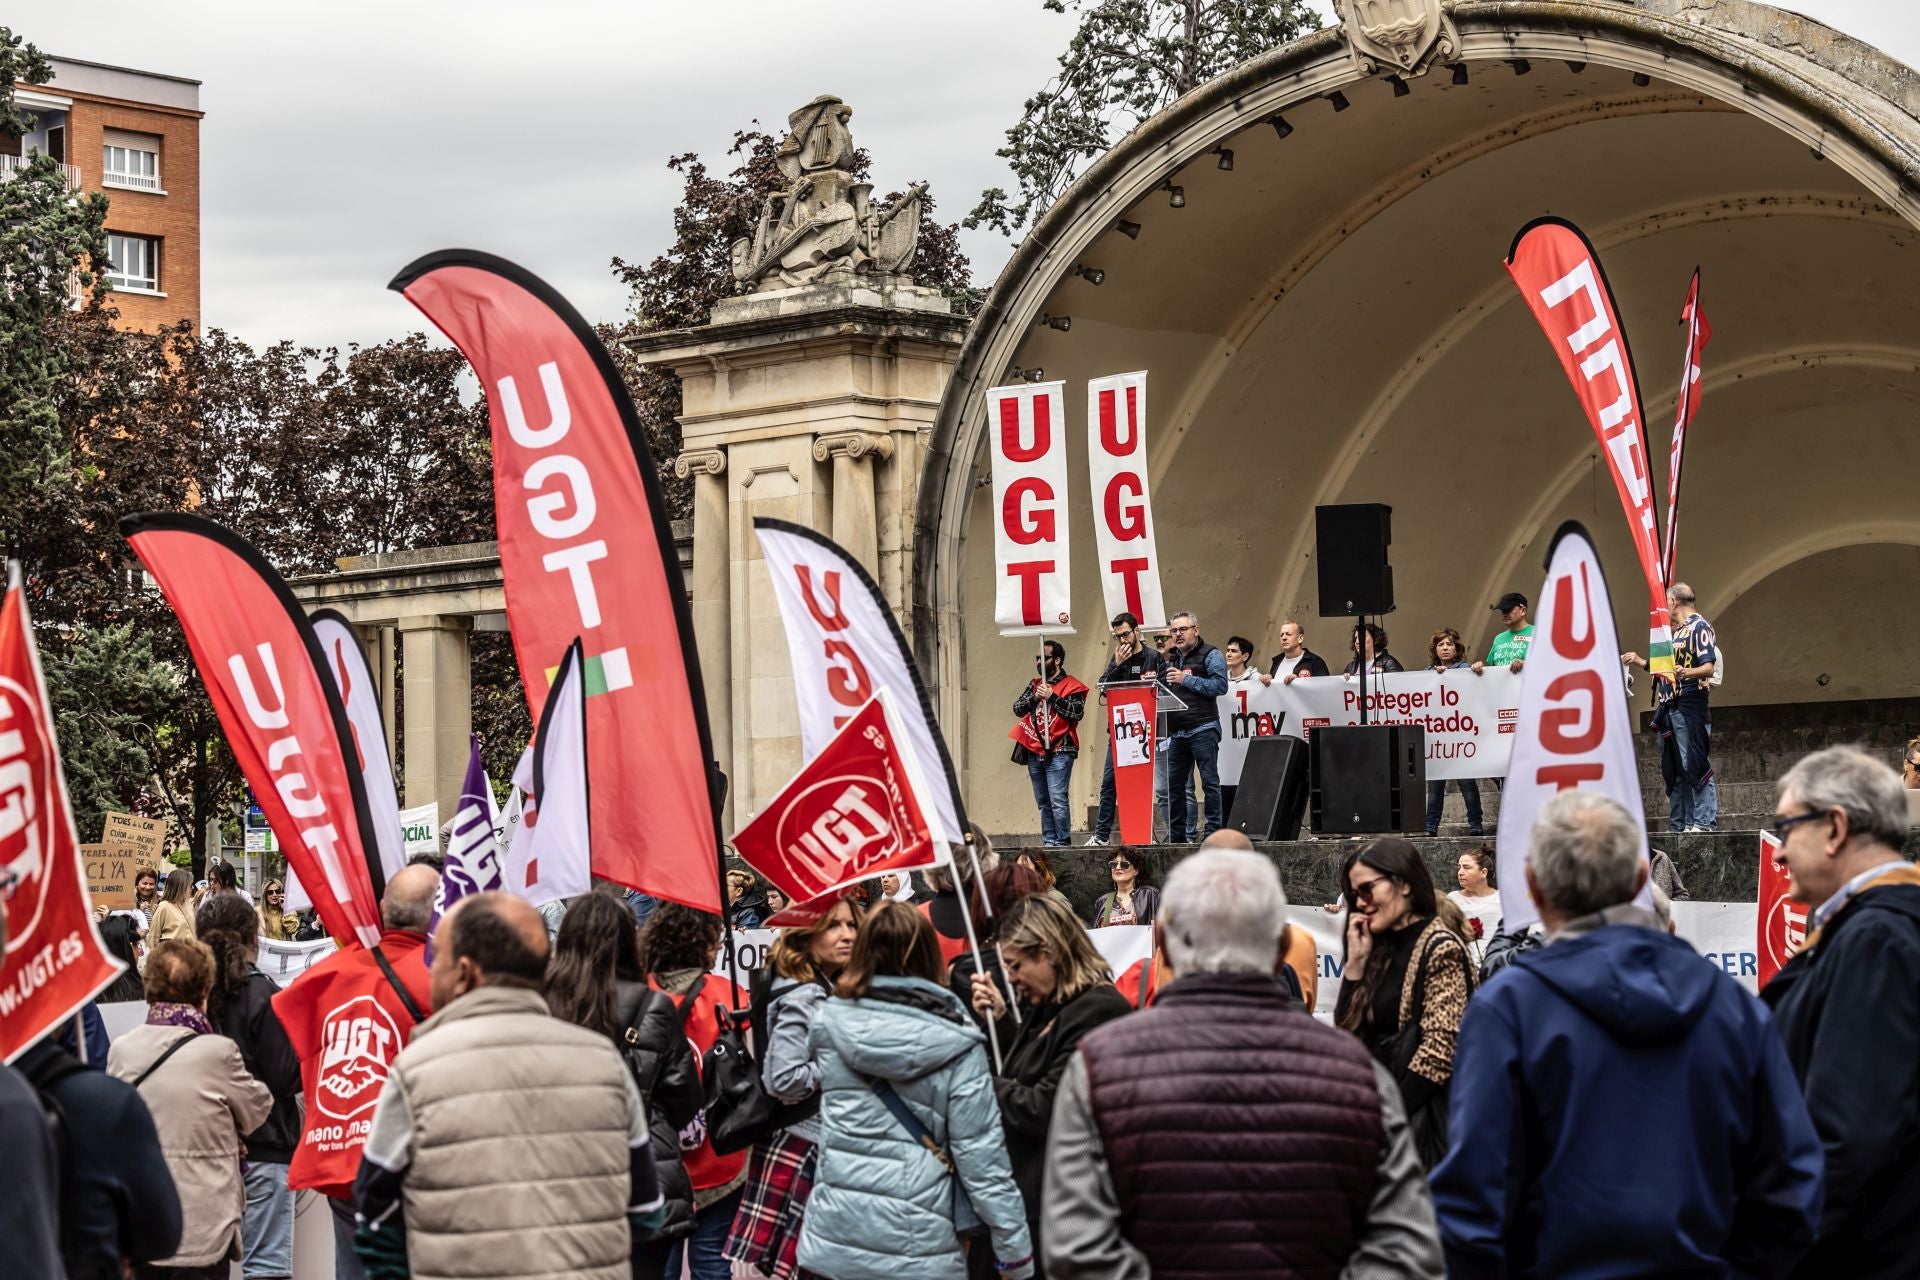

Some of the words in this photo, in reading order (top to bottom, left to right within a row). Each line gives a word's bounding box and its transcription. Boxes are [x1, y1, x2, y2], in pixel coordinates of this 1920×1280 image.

[1000, 394, 1055, 627] UGT
[1098, 386, 1149, 625] UGT
[1440, 685, 1459, 706] lo
[1425, 740, 1476, 760] uturo
[788, 784, 891, 885] UGT
[85, 861, 105, 879] C1
[111, 860, 126, 879] YA
[117, 849, 134, 858] CAR
[0, 930, 84, 1018] w.UGT.es
[322, 1016, 391, 1070] UGT
[305, 1125, 343, 1145] mano
